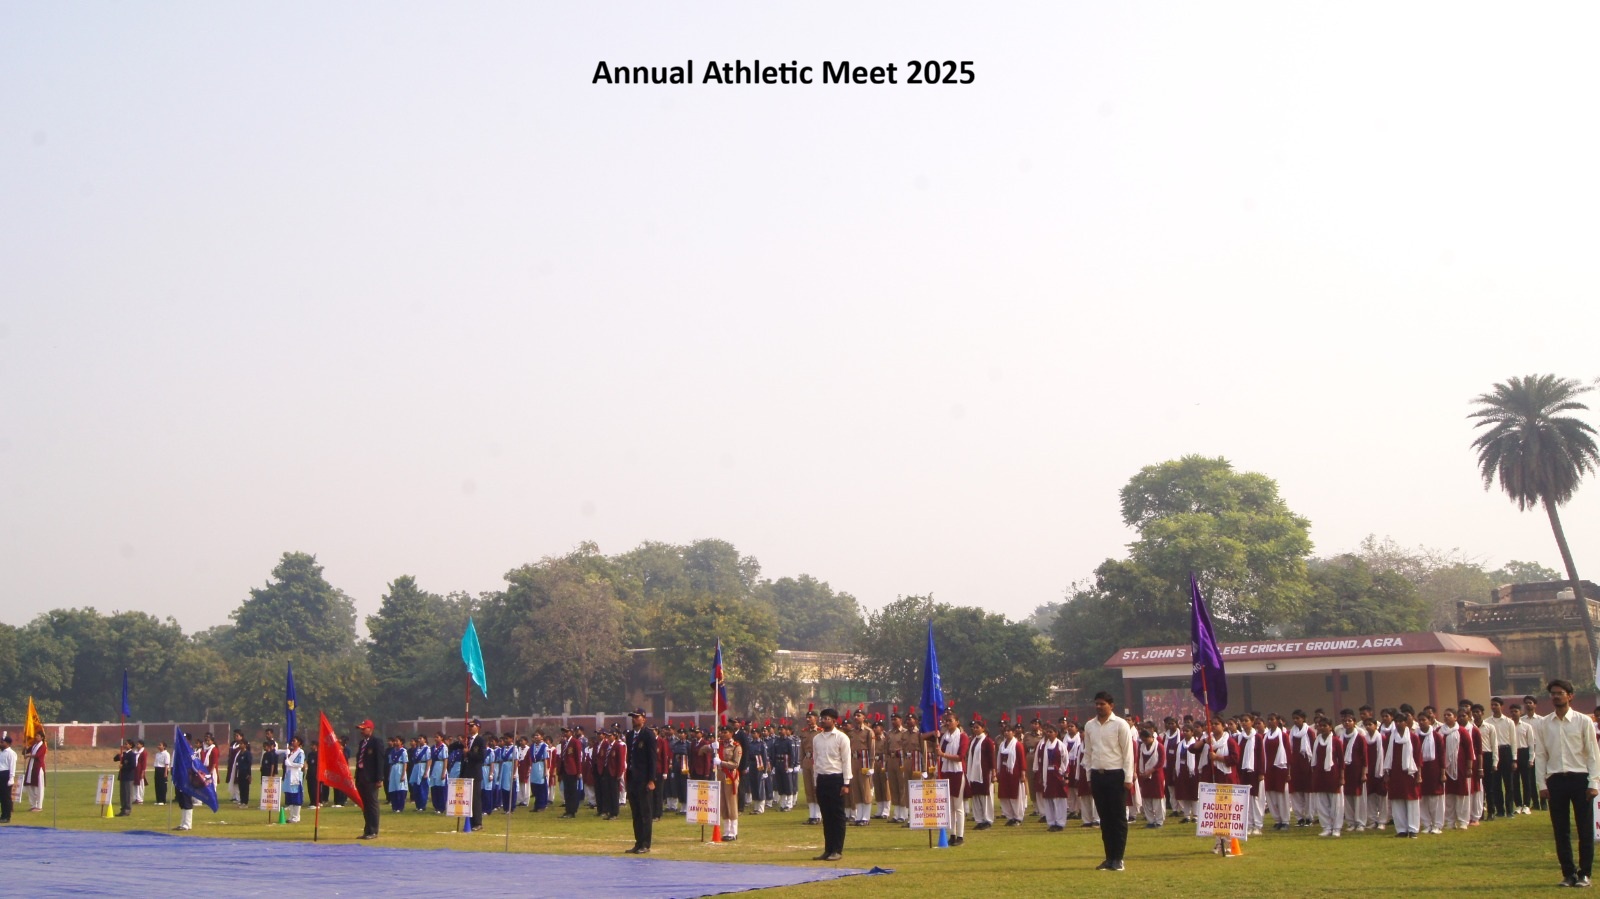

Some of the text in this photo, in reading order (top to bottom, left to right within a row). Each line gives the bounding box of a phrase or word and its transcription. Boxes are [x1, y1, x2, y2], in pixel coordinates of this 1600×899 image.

[1122, 650, 1139, 660] ST.
[1141, 648, 1187, 660] JOHN'S
[1249, 642, 1303, 654] CRICKET
[1361, 637, 1403, 648] AGRA
[1202, 802, 1232, 810] FACULTY
[1204, 812, 1241, 820] COMPUTER
[1201, 821, 1244, 830] APPLICATION
